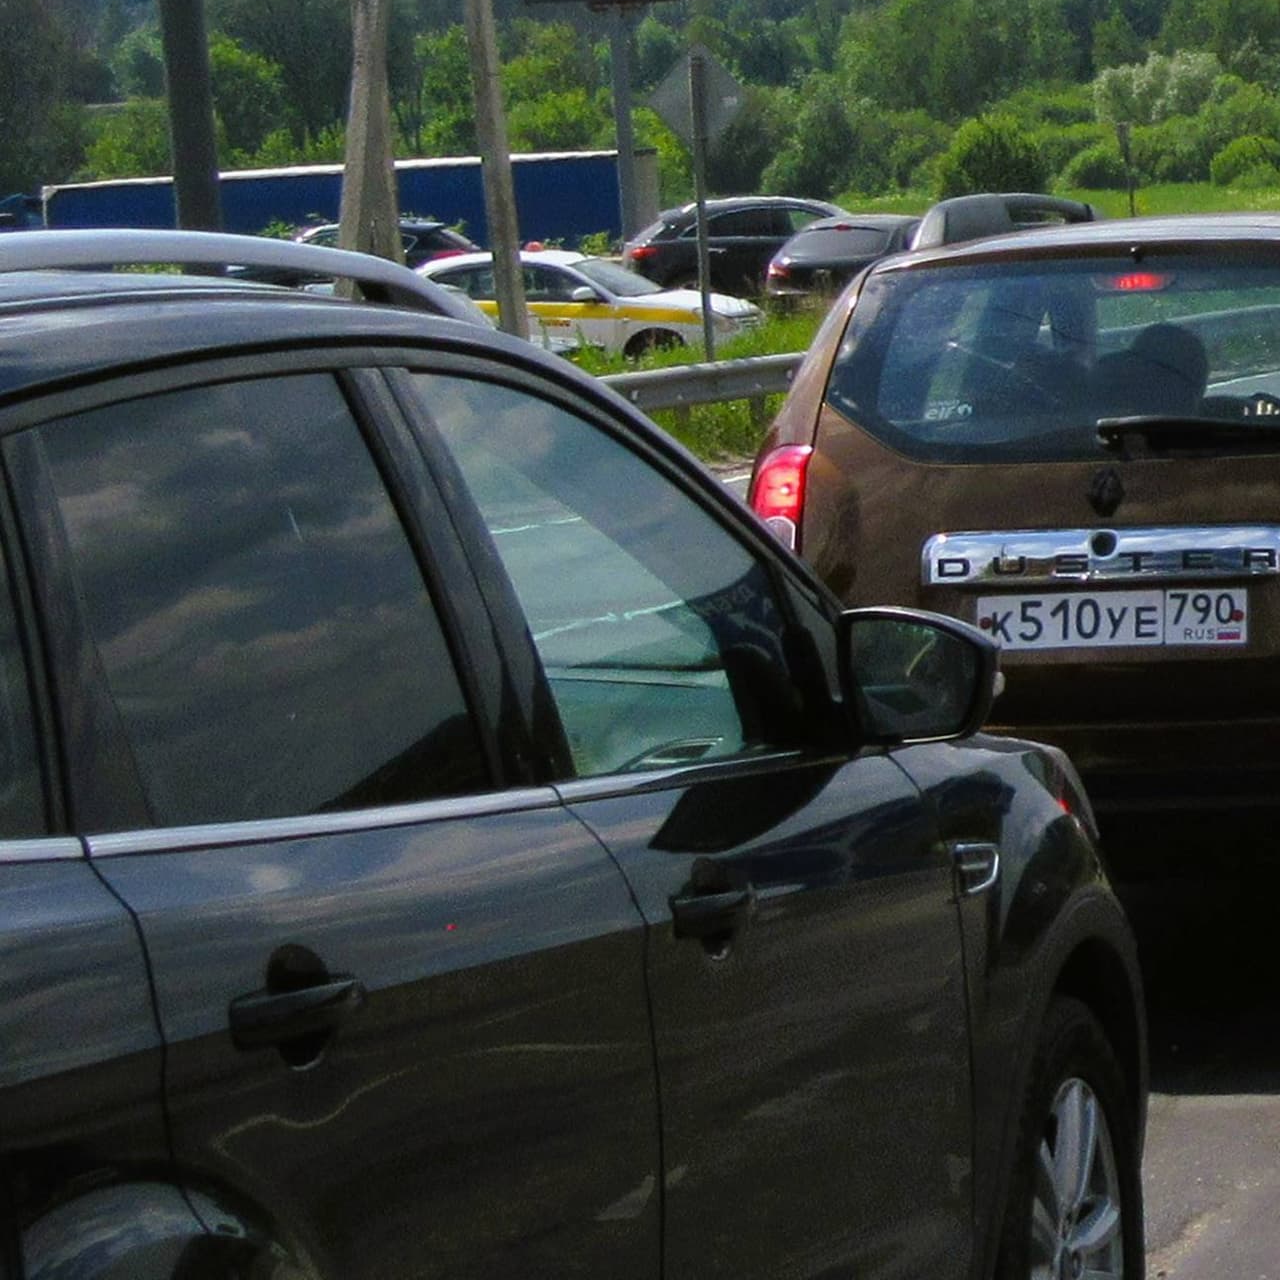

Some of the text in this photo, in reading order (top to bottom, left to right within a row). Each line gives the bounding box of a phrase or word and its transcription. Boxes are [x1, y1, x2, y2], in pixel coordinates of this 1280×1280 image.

[937, 548, 1276, 580] DUSTER
[1169, 592, 1235, 626] 790
[1184, 629, 1215, 641] RUS
